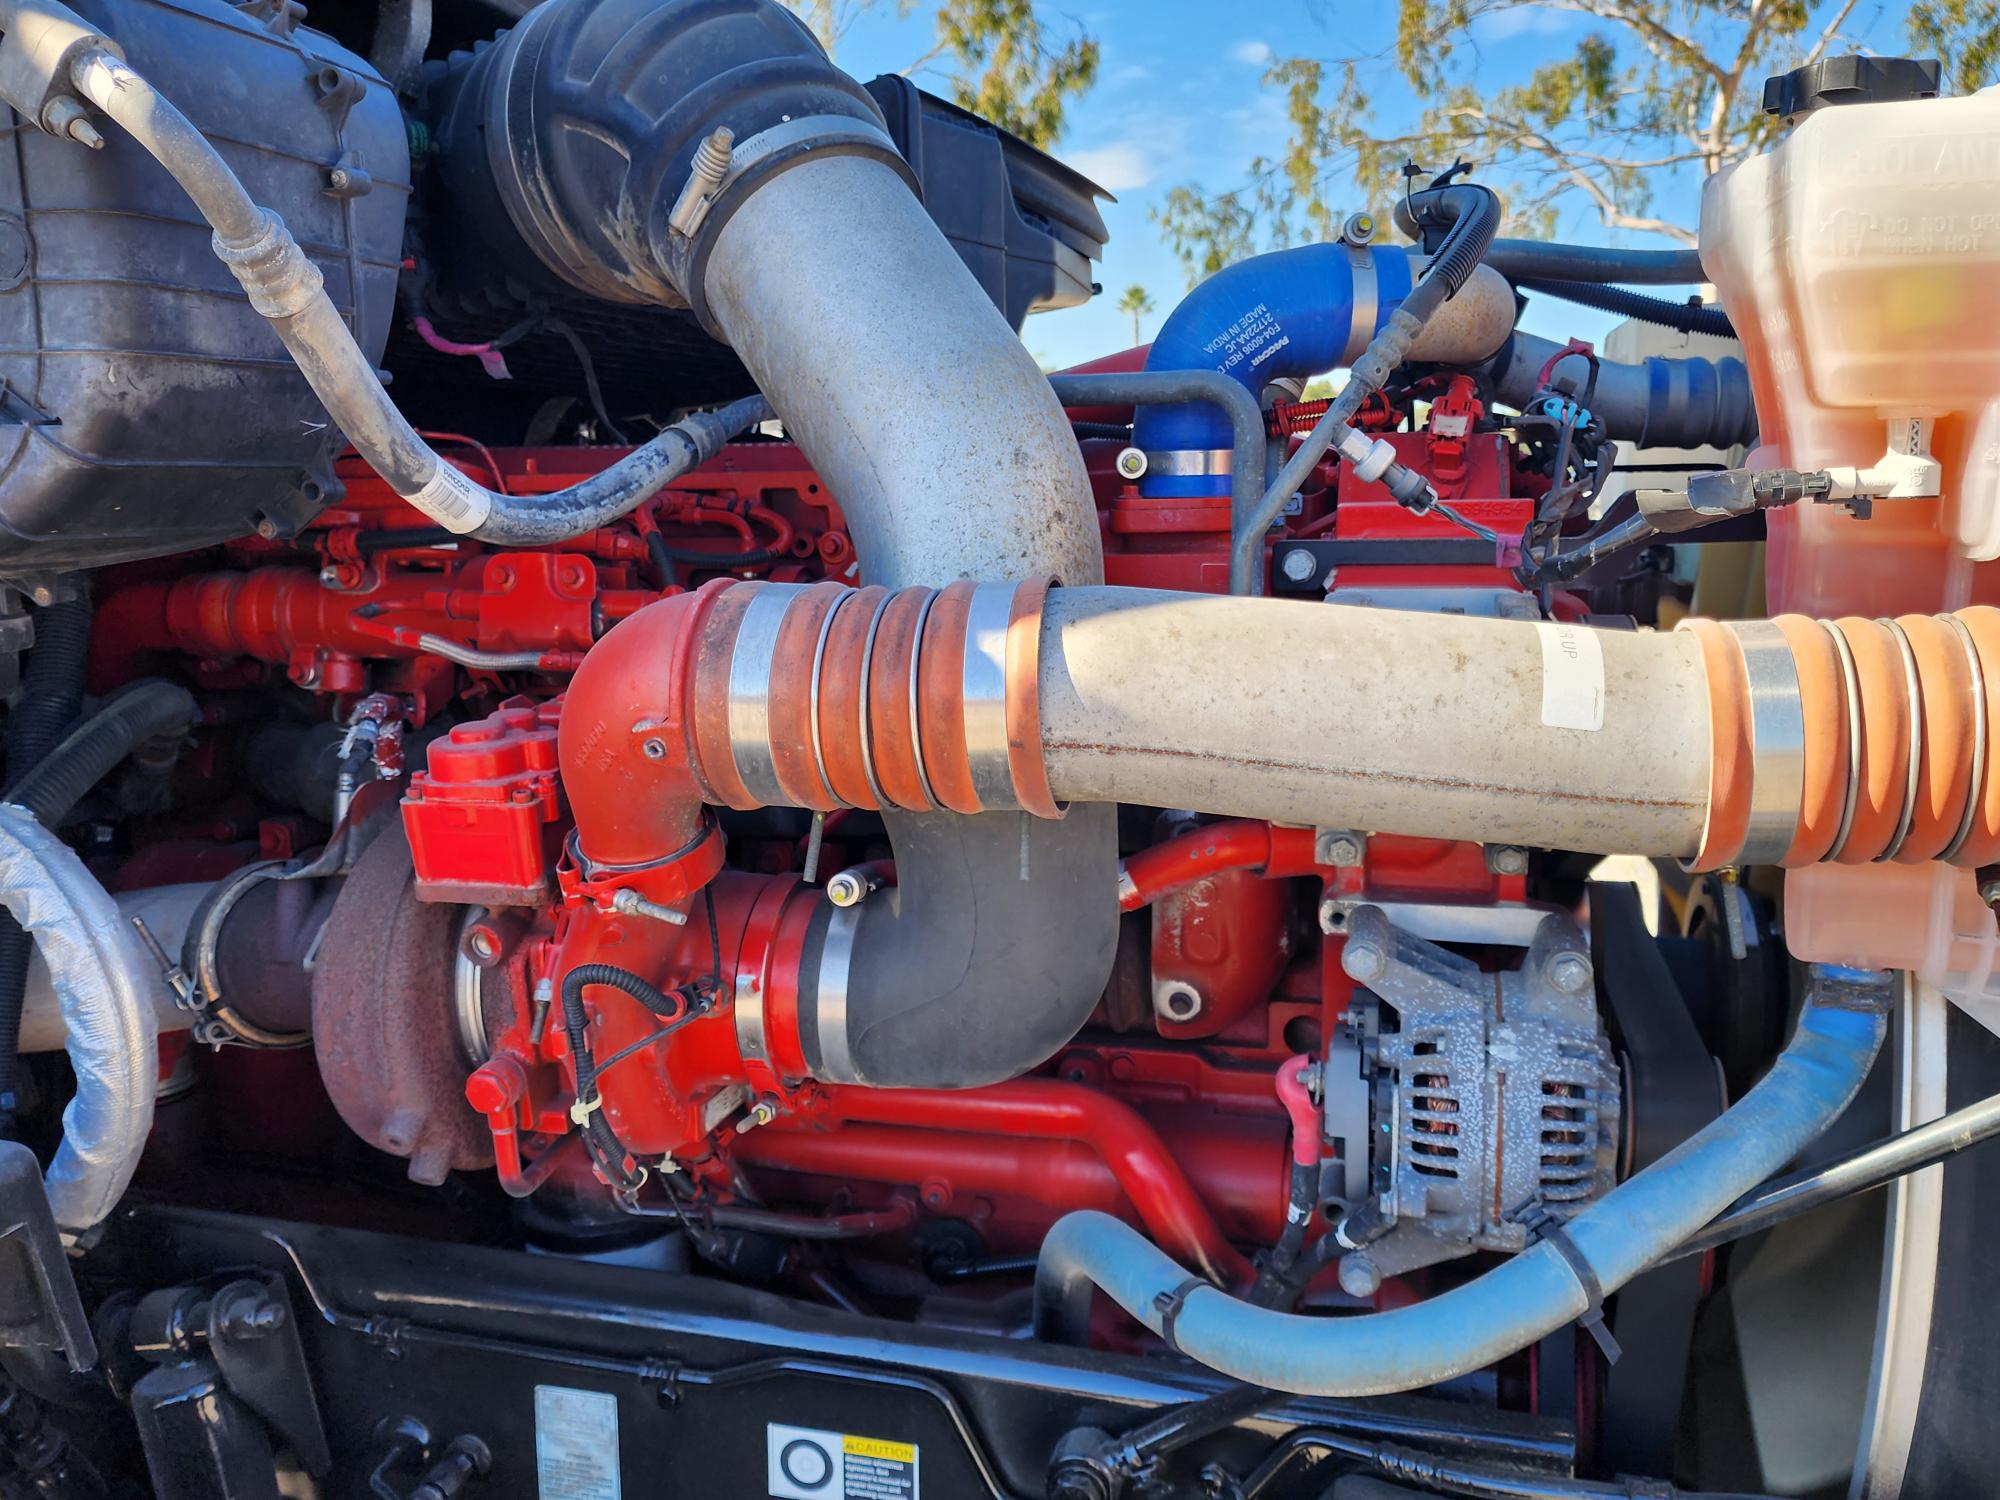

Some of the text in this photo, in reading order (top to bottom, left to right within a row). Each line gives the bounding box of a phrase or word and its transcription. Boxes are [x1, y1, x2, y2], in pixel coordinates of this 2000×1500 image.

[1920, 215, 1958, 233] NOT
[1944, 233, 1983, 252] HOT
[1202, 303, 1267, 354] MADE IN INDIA
[1225, 312, 1274, 354] 21722AA JC
[1242, 322, 1281, 355] F04-6006
[1224, 352, 1245, 370] REV
[1250, 335, 1290, 366] PACCAR
[443, 467, 471, 495] PACCAR
[857, 1442, 913, 1459] CAUTION
